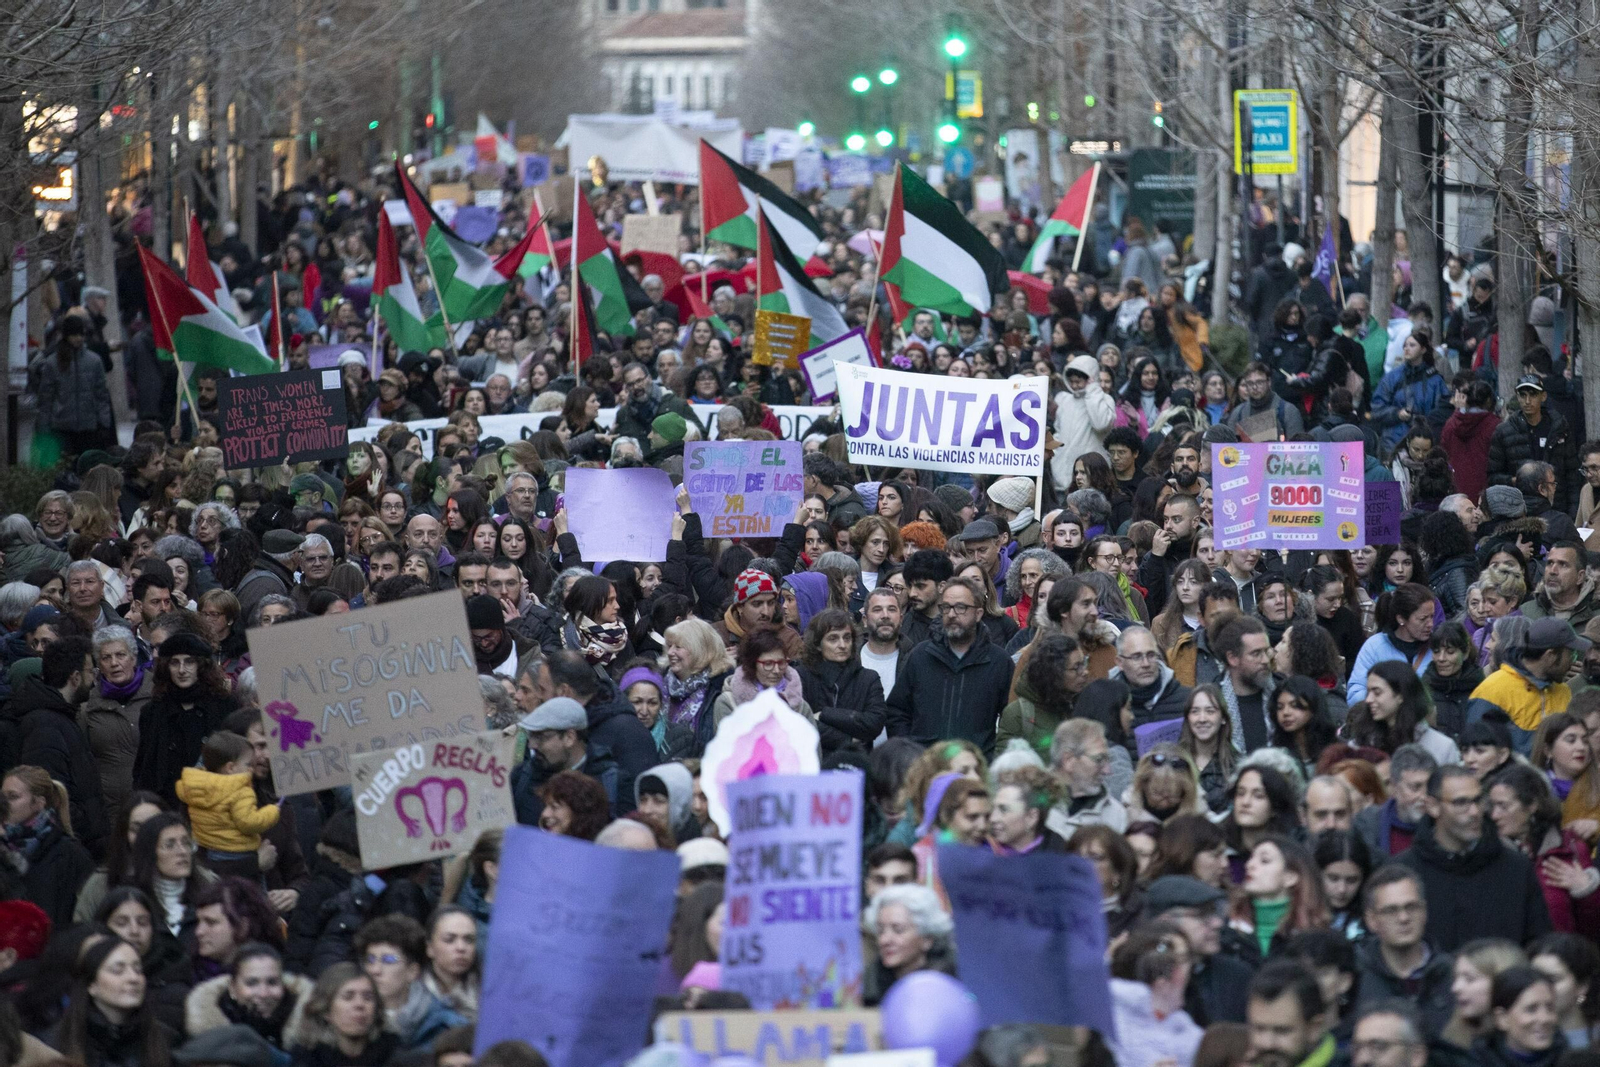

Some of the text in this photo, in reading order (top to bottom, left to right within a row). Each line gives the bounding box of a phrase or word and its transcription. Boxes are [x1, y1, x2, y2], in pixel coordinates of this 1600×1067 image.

[230, 380, 317, 406] TRANS WOMEN
[225, 405, 334, 431] LIKELY TO EXPERIENCE
[227, 394, 324, 420] ARE 4 TIMES MORE
[845, 381, 1042, 450] JUNTAS
[245, 418, 327, 437] VIOLENT CRIMES
[224, 433, 280, 467] PROTECT
[760, 447, 786, 466] EL
[888, 445, 909, 459] LAS
[913, 447, 975, 464] VIOLENCIAS
[979, 451, 1040, 467] MACHISTAS
[1266, 454, 1322, 476] GAZA
[744, 472, 766, 493] DE
[773, 473, 803, 491] LAS
[1271, 486, 1322, 505] 9000
[724, 494, 744, 514] YA
[763, 495, 793, 516] NO
[1365, 501, 1391, 513] XISTA
[712, 512, 771, 536] ESTÁN
[1271, 514, 1322, 524] MUJERES
[1372, 526, 1392, 537] SEA
[336, 620, 389, 649] TU
[321, 688, 432, 733] ME DA
[431, 742, 507, 788] REGLAS
[356, 743, 426, 816] CUERPO
[810, 792, 853, 826] NO
[756, 842, 847, 881] MUEVE
[762, 886, 854, 923] SIENTE
[679, 1018, 868, 1065] LLAMA
